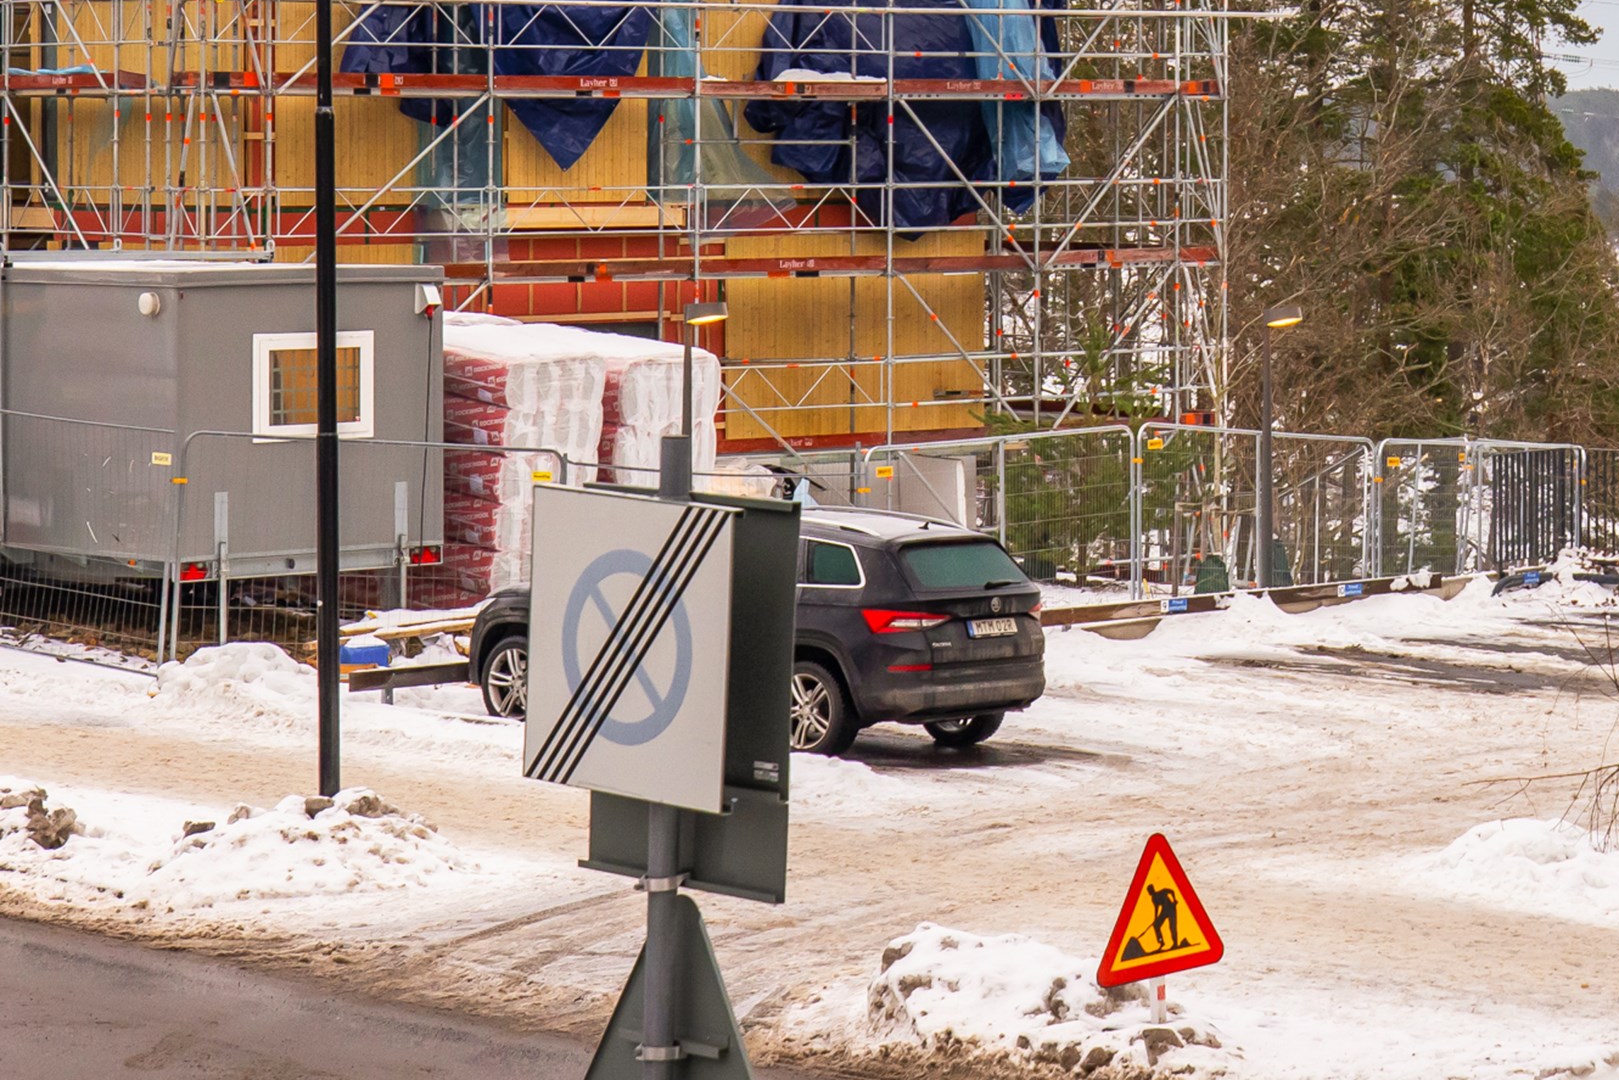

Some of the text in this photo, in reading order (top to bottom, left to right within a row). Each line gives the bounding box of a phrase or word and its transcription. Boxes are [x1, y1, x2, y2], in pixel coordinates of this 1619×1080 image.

[580, 78, 607, 88] Layher
[779, 260, 805, 270] Layher
[974, 621, 994, 634] MTM
